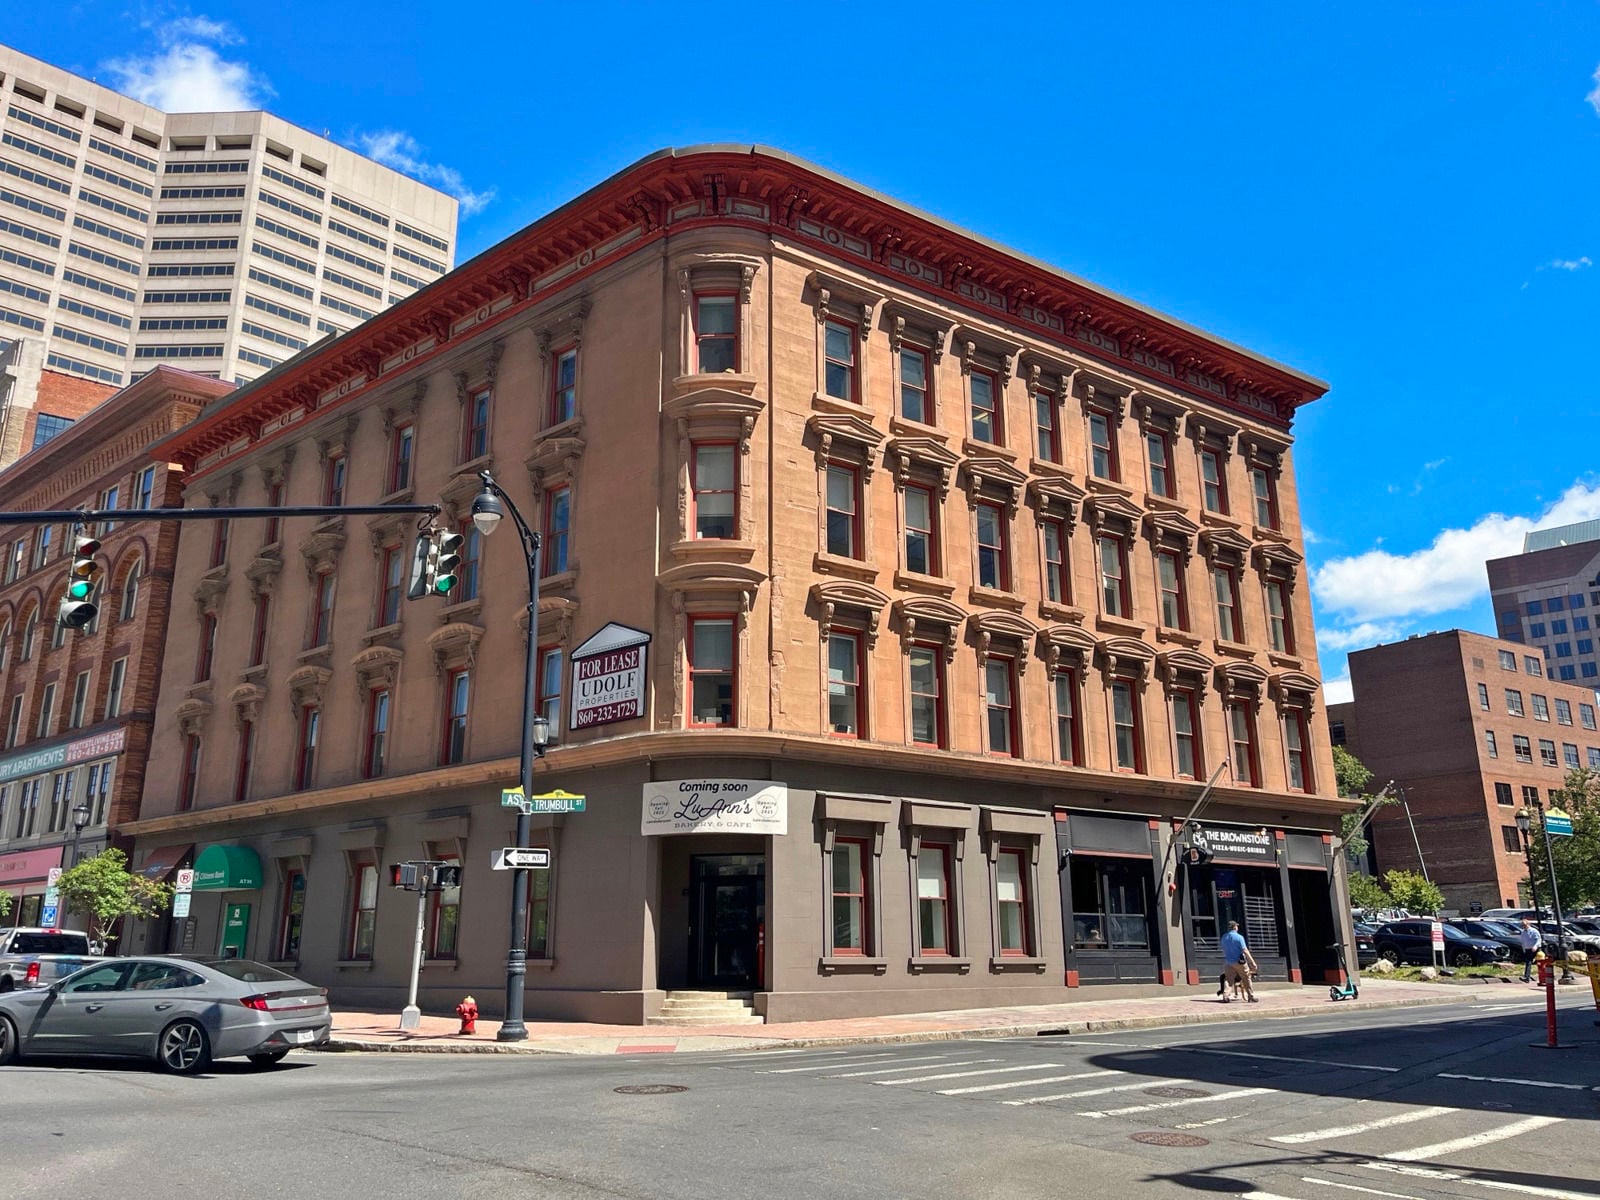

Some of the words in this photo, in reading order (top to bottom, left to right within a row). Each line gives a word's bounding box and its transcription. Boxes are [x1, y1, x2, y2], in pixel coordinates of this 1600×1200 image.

[581, 659, 601, 678] FOR
[604, 650, 638, 673] LEASE
[582, 671, 636, 697] UDOLF
[580, 689, 636, 706] PROPERTIES
[578, 701, 636, 725] 860-232-1729
[12, 749, 65, 773] APARTMENTS
[679, 781, 720, 794] Coming
[722, 782, 749, 792] soon
[534, 799, 575, 811] TRUMBULL
[674, 793, 753, 821] LuAnn's
[674, 821, 713, 829] BAKERY
[1205, 830, 1220, 841] THE
[1220, 831, 1270, 845] BROWNSTONE
[517, 854, 530, 862] ONE
[532, 854, 545, 862] WAY
